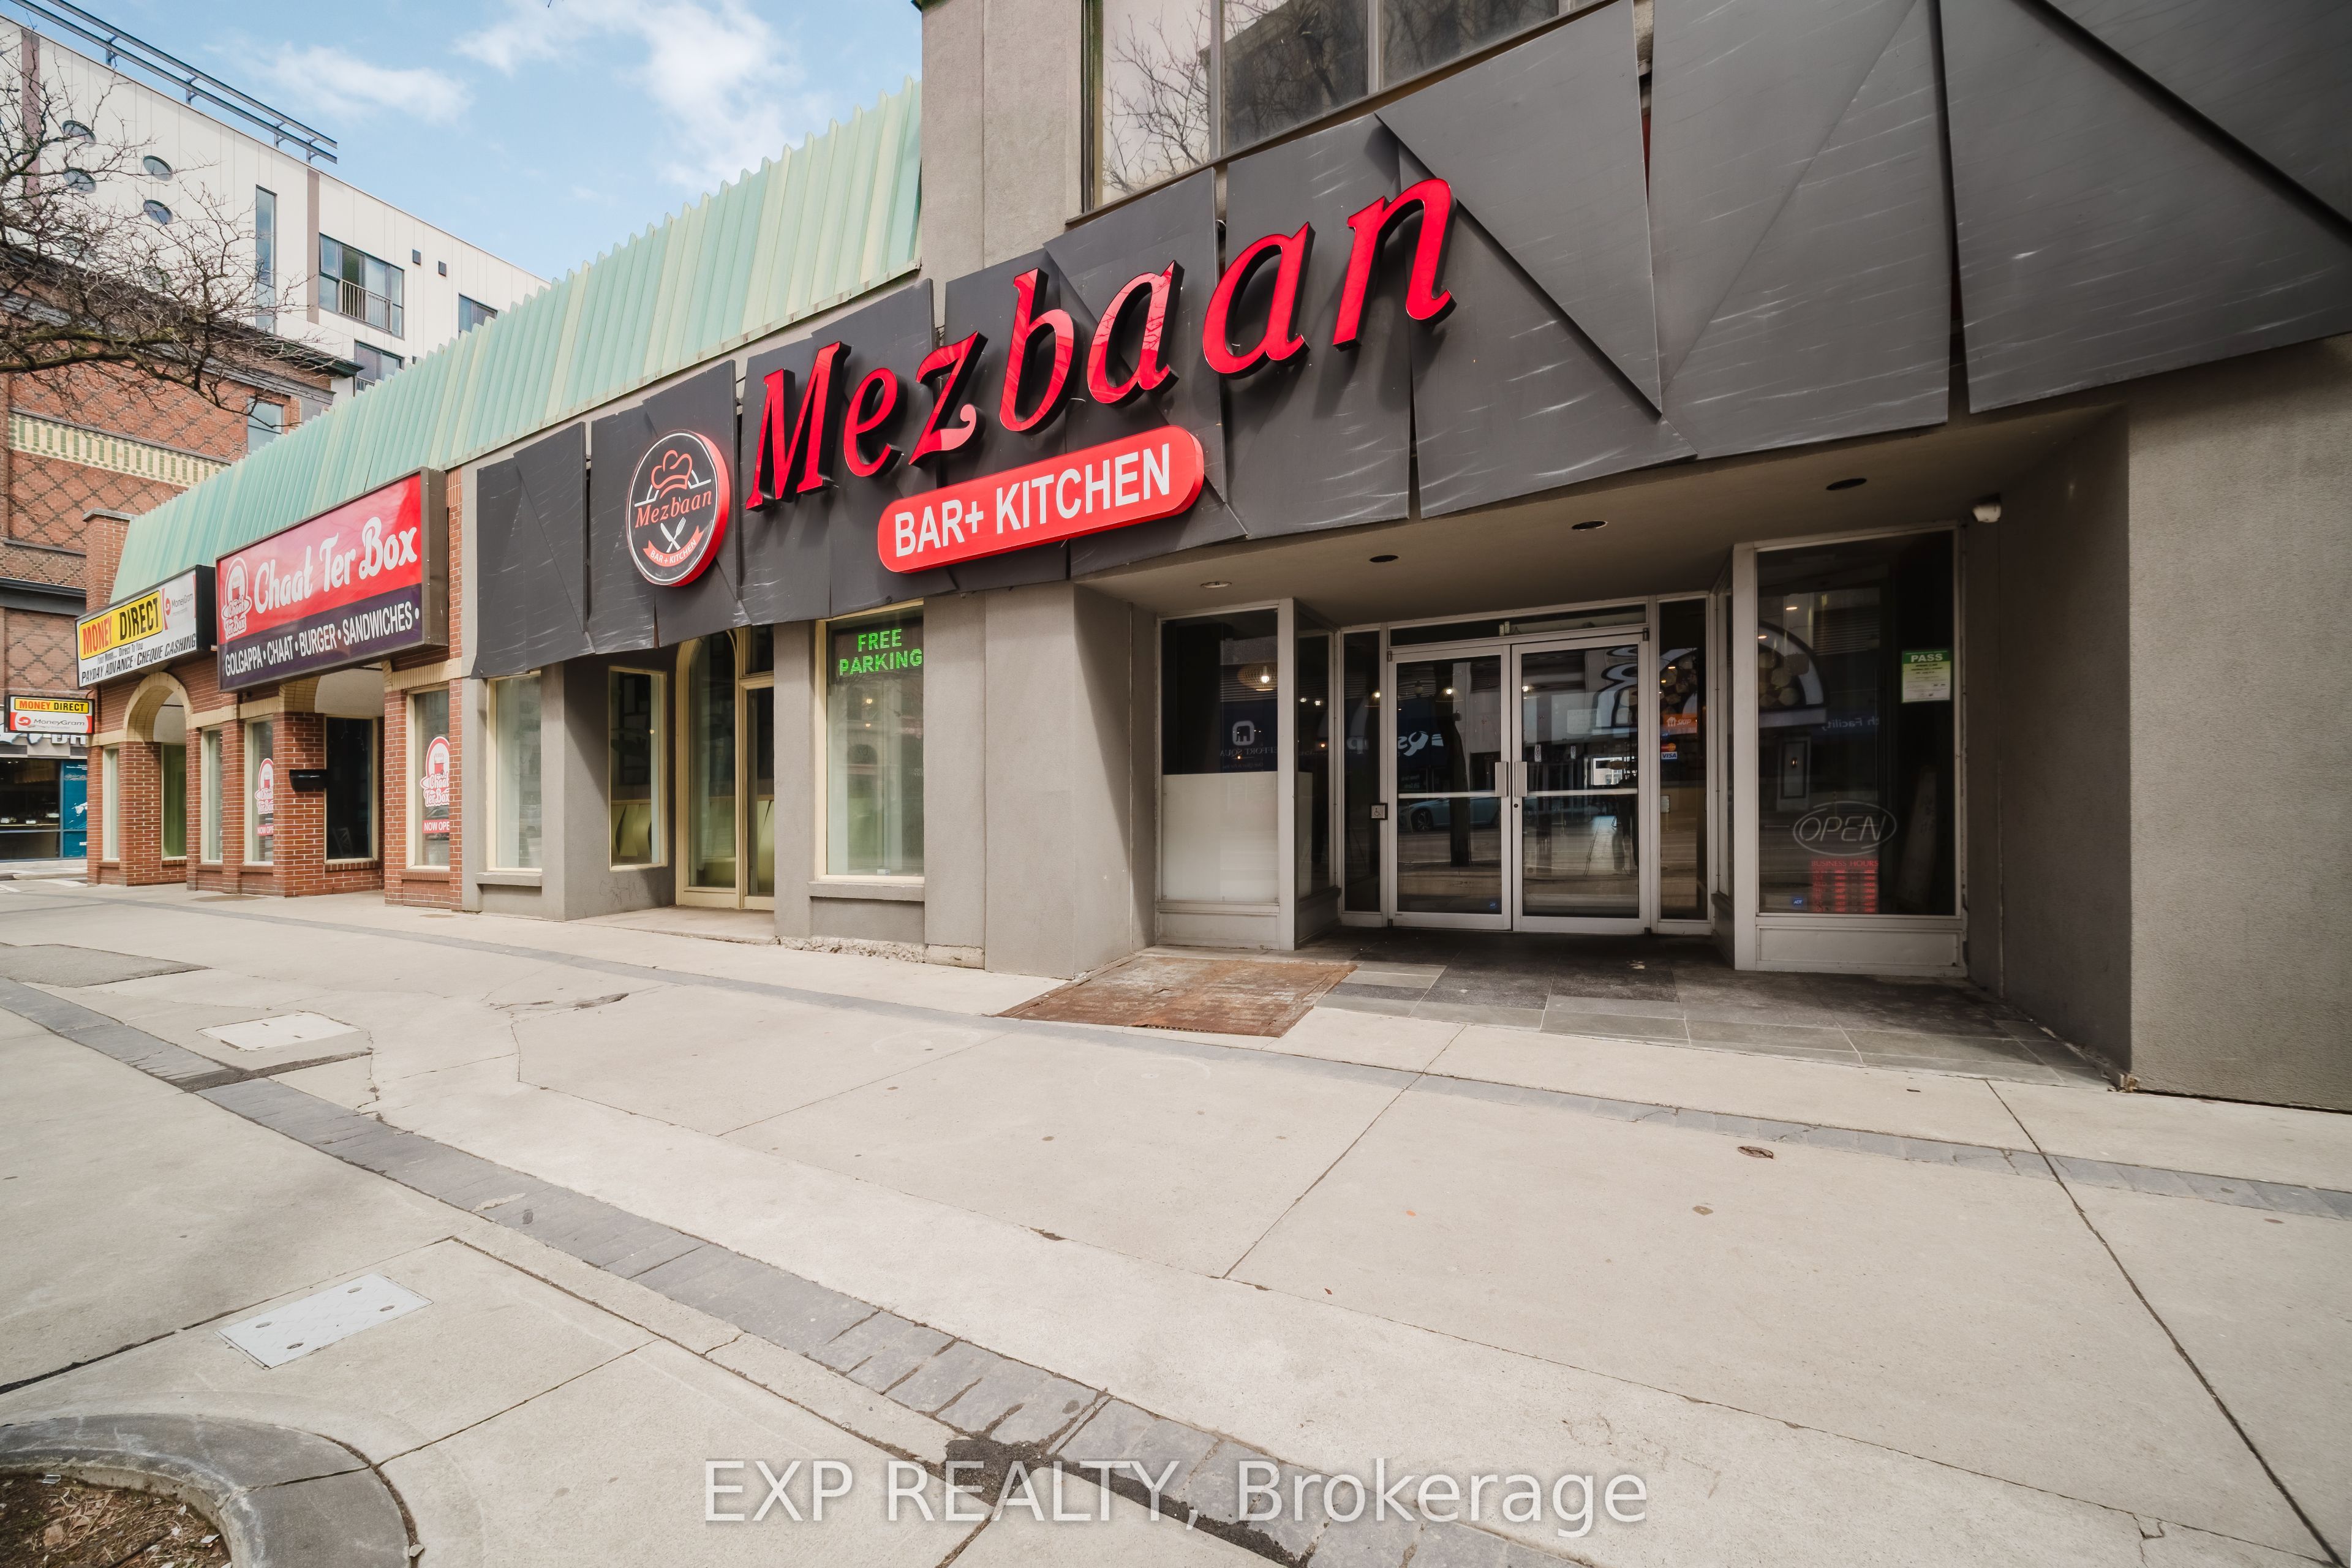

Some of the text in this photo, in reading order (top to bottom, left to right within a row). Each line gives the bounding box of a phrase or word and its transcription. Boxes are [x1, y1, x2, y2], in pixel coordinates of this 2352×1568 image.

[745, 178, 1458, 513] Mezbaan
[997, 442, 1171, 535] KITCHEN
[635, 491, 712, 529] Mezbaan
[650, 549, 663, 563] BAR
[669, 540, 697, 563] KITCHEN
[254, 517, 418, 614] Chaat Ter Box
[172, 593, 194, 608] MoneyGram
[228, 594, 245, 618] Chaat
[83, 597, 159, 655] MONEY DIRECT
[119, 646, 131, 657] Direct
[132, 644, 135, 652] To
[225, 601, 413, 676] GOLGAPPA CHAAT BURGER SANDWICHES
[858, 628, 902, 652] FREE
[82, 633, 196, 684] PAYDAY ADVANCE CHEQUE CASHING
[839, 649, 922, 676] PARKING
[1911, 653, 1943, 663] PASS
[20, 700, 85, 712] MONEY DIRECT
[429, 771, 450, 789] Chaat
[425, 790, 435, 805] Ter
[424, 821, 450, 831] NOW OPE
[1799, 816, 1887, 842] OPEN
